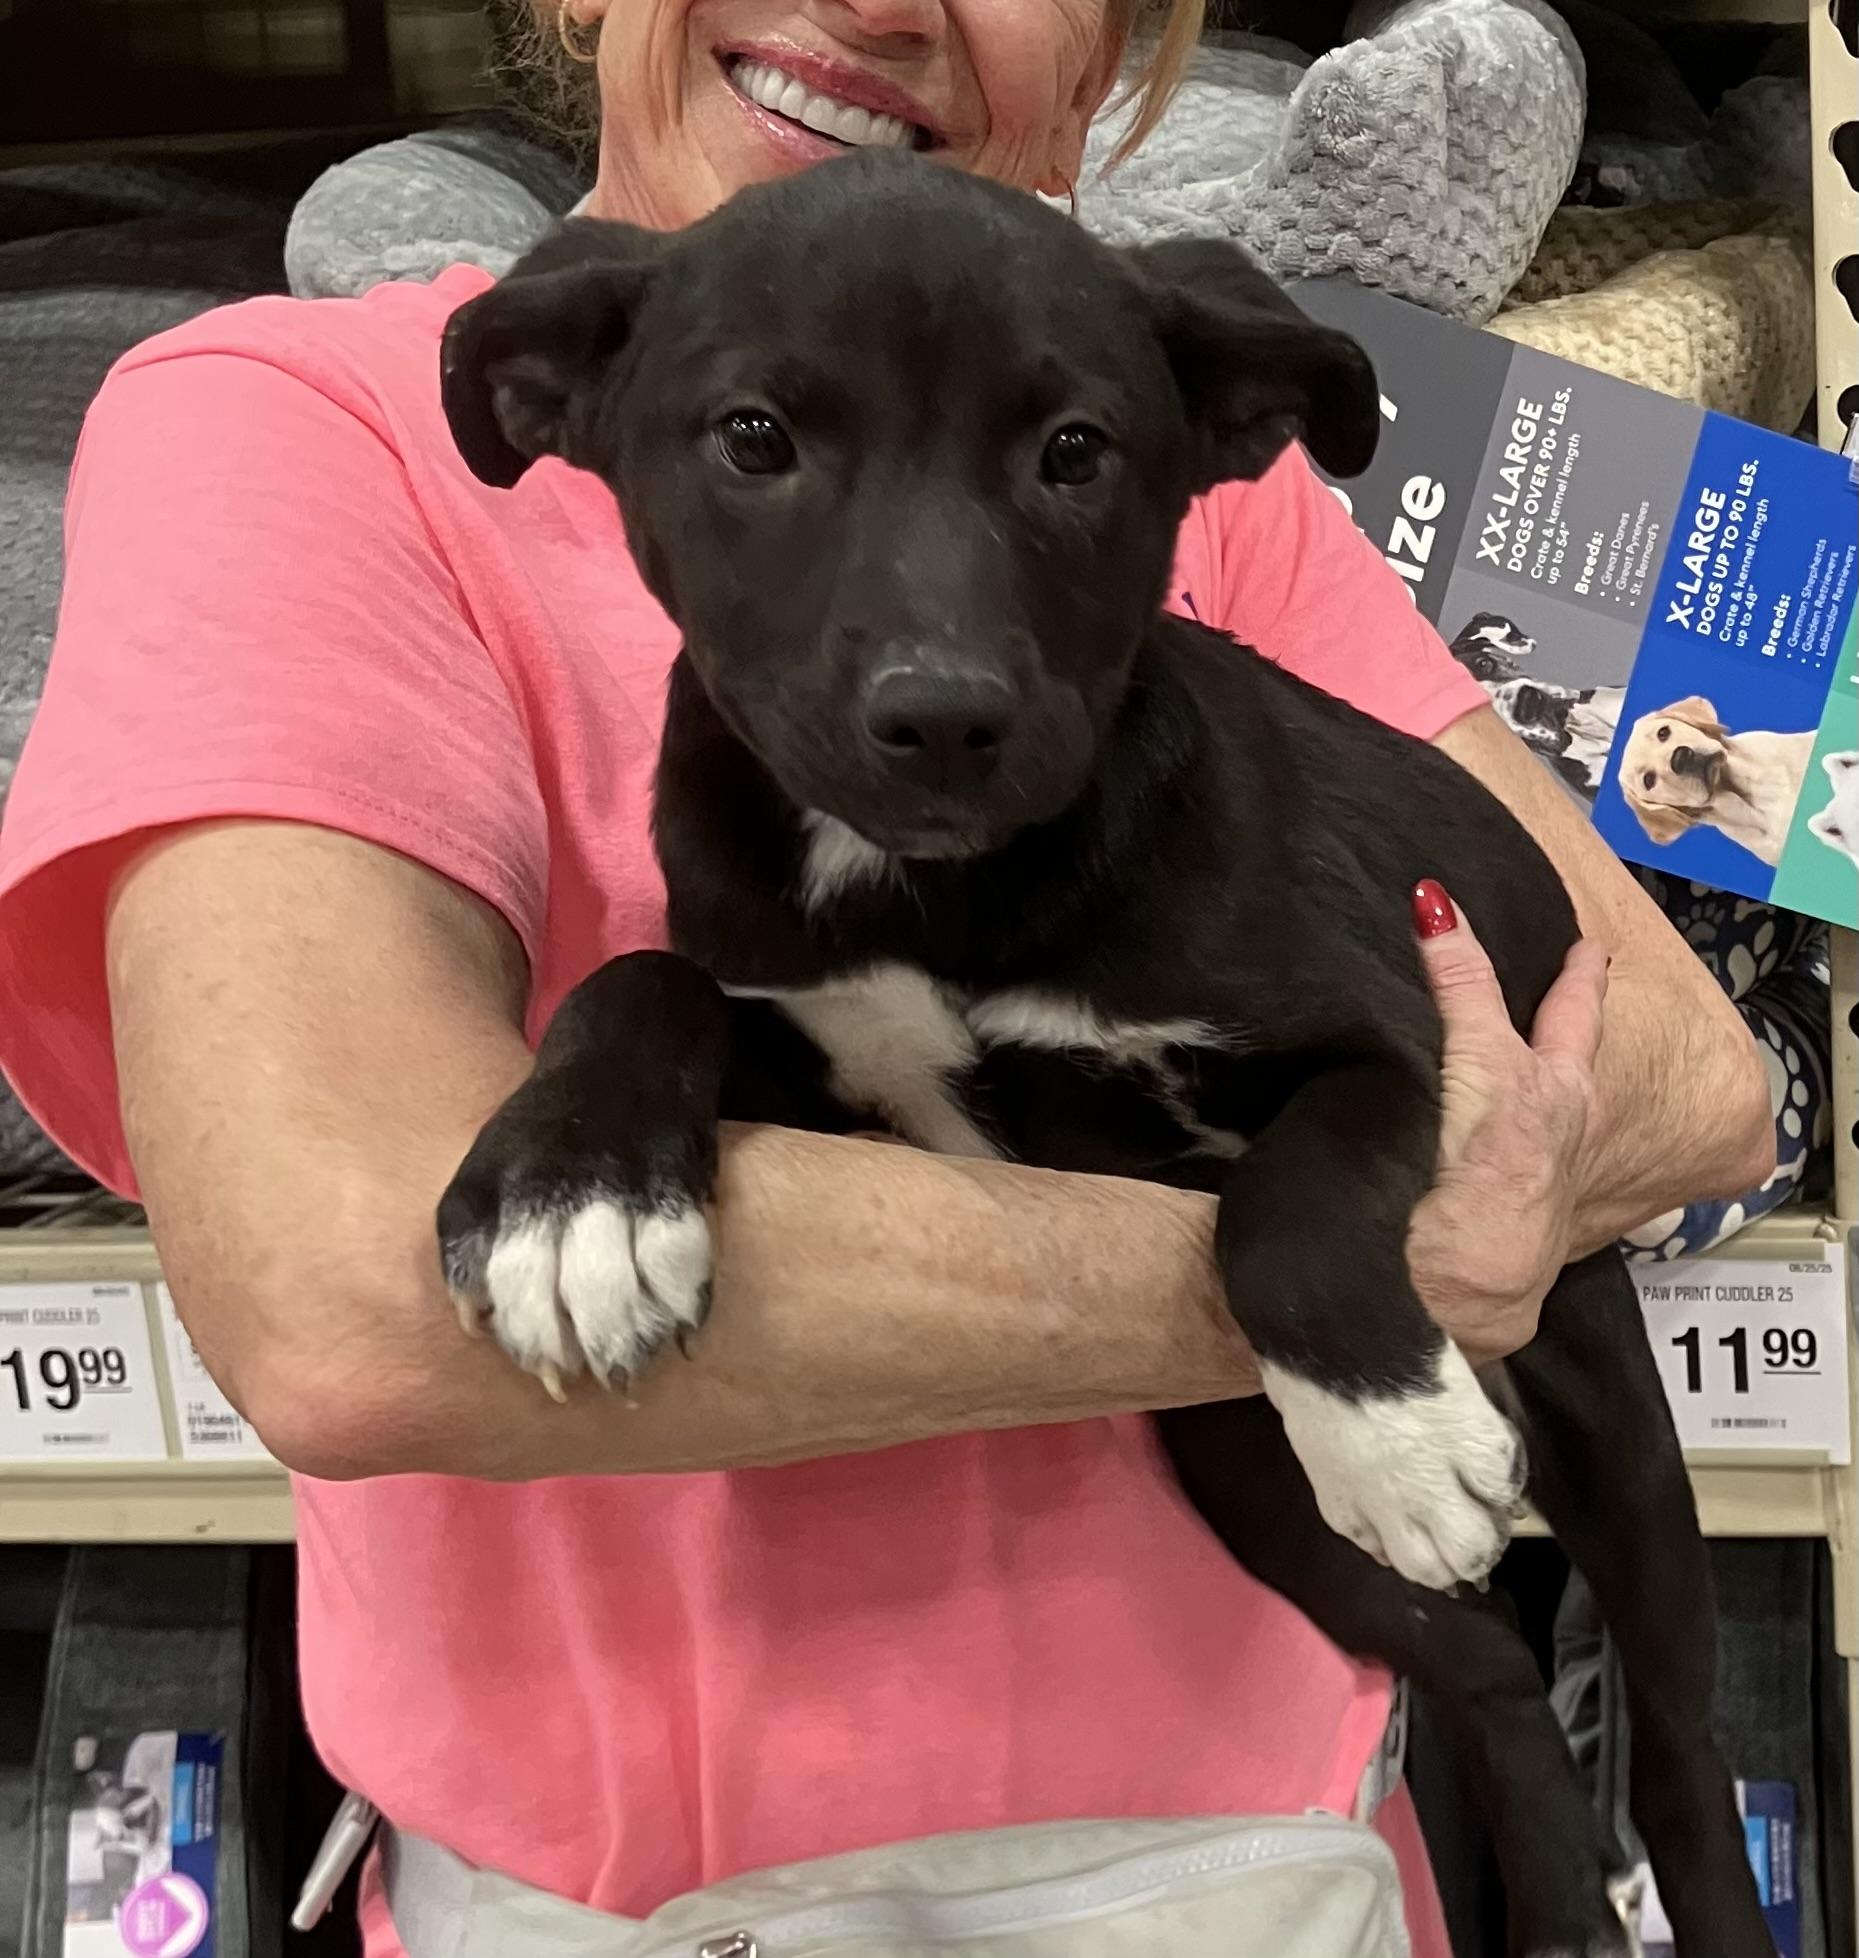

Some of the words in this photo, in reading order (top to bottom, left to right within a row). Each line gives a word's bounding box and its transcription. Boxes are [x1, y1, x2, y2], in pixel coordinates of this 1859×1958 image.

[1559, 433, 1582, 478] length
[1736, 459, 1760, 498] LBS.
[1476, 397, 1543, 566] XX-LARGE
[1507, 517, 1535, 572] DOGS
[1524, 463, 1550, 515] OVER
[1539, 428, 1558, 460] 90+
[1549, 387, 1573, 425] LBS.
[1545, 478, 1569, 524] kennel
[1542, 527, 1555, 538] &
[1729, 499, 1747, 523] 90
[1747, 498, 1770, 543] length
[1385, 475, 1446, 606] ize
[1530, 540, 1551, 580] Crate
[1553, 549, 1565, 564] to
[1601, 551, 1620, 586] Great
[1611, 512, 1630, 549] Danes
[1615, 556, 1635, 591] Great
[1626, 501, 1650, 555] Pyrenees
[1666, 487, 1727, 630] X-LARGE
[1719, 525, 1739, 550] TO
[1547, 568, 1560, 585] up
[1574, 531, 1605, 595] Breeds:
[1712, 553, 1730, 579] UP
[1734, 542, 1757, 588] kennel
[1696, 581, 1724, 636] DOGS
[1731, 591, 1743, 602] &
[1787, 601, 1809, 648] German
[1801, 539, 1827, 600] Shepherds
[1801, 610, 1822, 652] Golden
[1814, 551, 1839, 609] Retrievers
[1815, 604, 1839, 657] Labrador
[1831, 545, 1857, 602] Retrievers
[1719, 603, 1740, 642] Crate
[1736, 630, 1749, 647] up
[1740, 612, 1753, 627] to
[1761, 594, 1792, 657] Breeds:
[1643, 1286, 1671, 1301] PAW
[1675, 1287, 1711, 1301] PRINT
[1715, 1287, 1775, 1302] CUDDLER
[1777, 1287, 1794, 1302] 25
[0, 1347, 81, 1411] 19
[78, 1347, 127, 1385] 99
[1672, 1327, 1749, 1393] 11
[1762, 1328, 1818, 1369] 99
